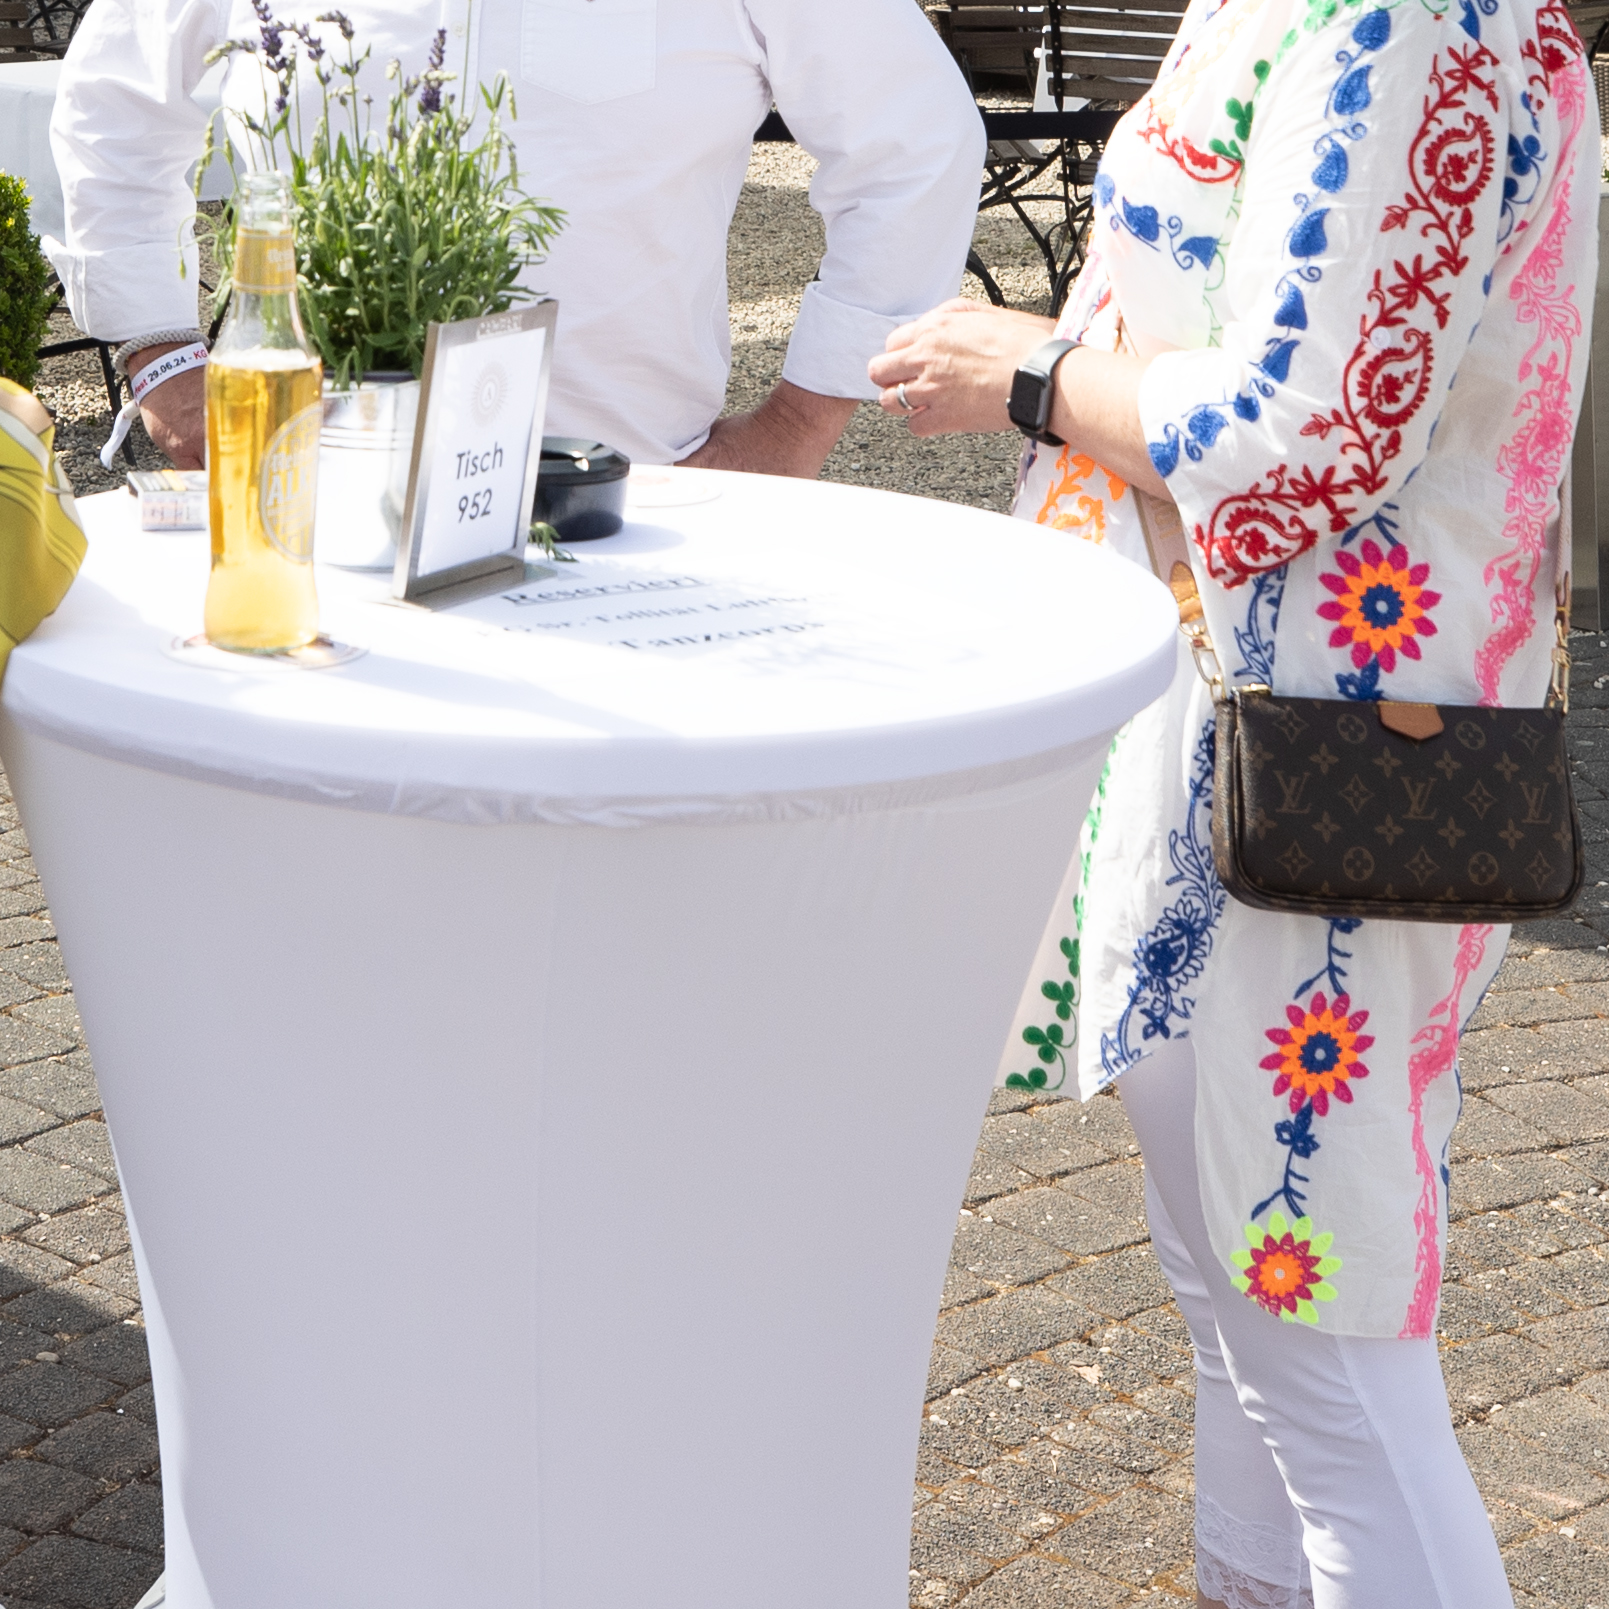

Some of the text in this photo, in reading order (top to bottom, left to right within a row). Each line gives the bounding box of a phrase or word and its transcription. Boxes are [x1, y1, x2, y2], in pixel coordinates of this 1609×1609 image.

[148, 356, 187, 382] 29.06.24
[456, 442, 503, 480] Tisch
[458, 488, 493, 523] 952
